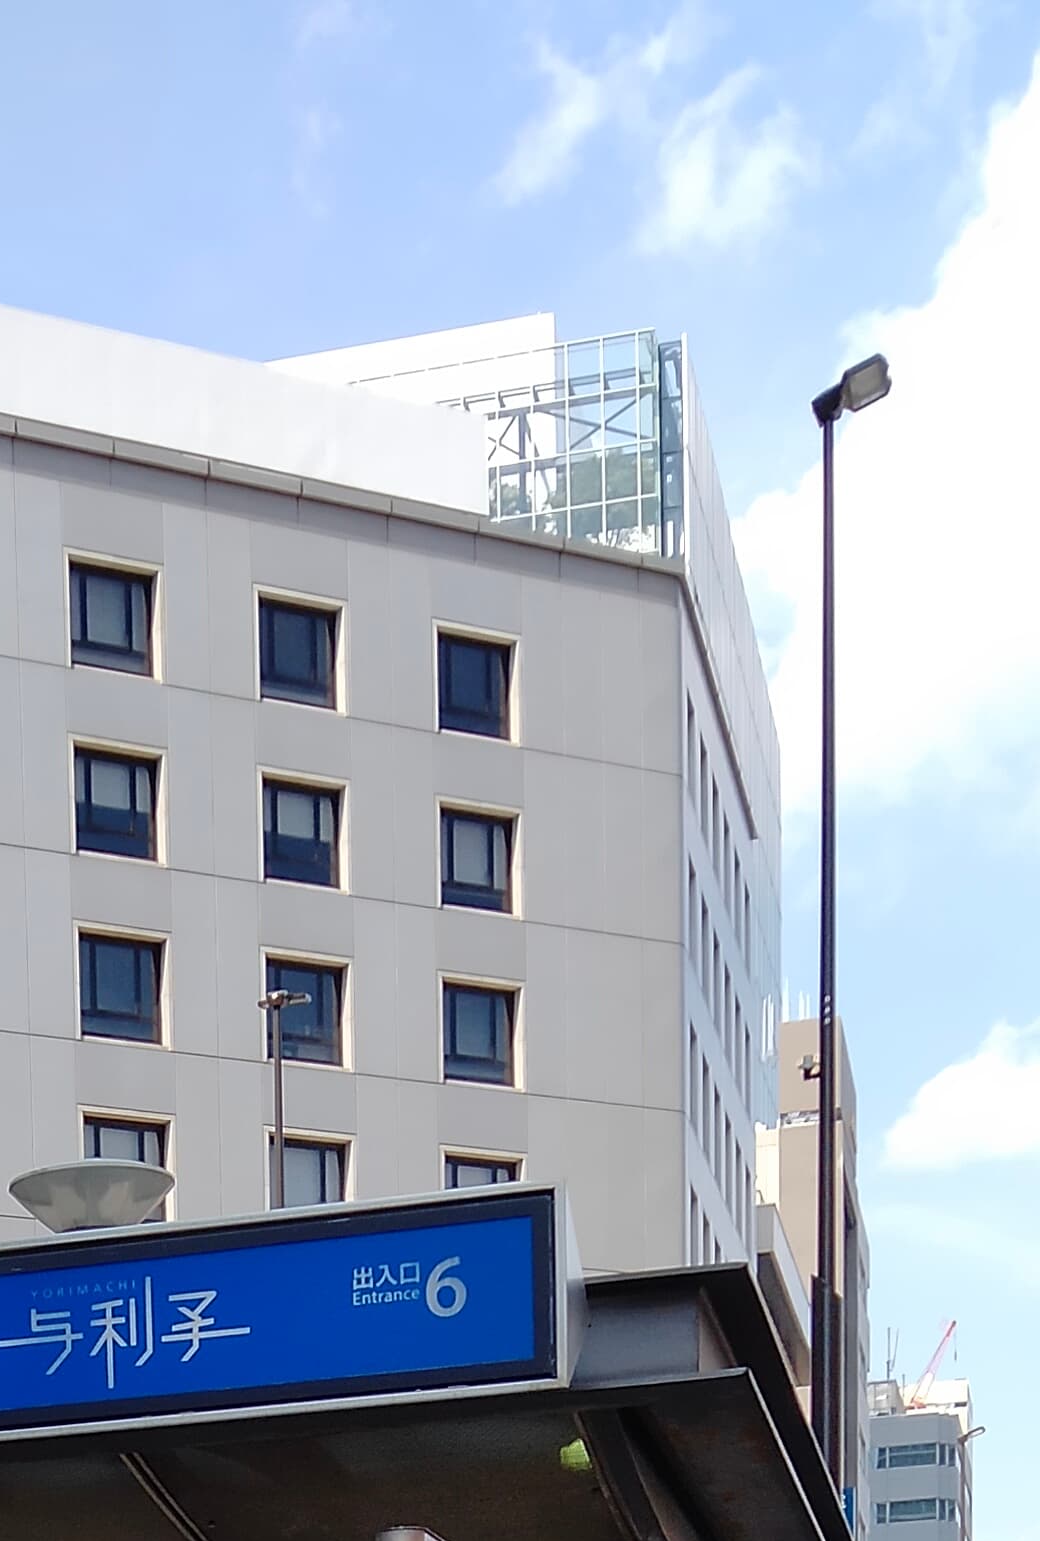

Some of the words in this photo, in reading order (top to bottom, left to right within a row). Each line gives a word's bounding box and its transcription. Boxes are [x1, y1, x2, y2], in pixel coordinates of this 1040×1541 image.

[352, 1262, 420, 1290] 出入口
[426, 1256, 467, 1317] 6
[31, 1279, 137, 1299] YORIMACHI
[352, 1288, 420, 1306] Entrance
